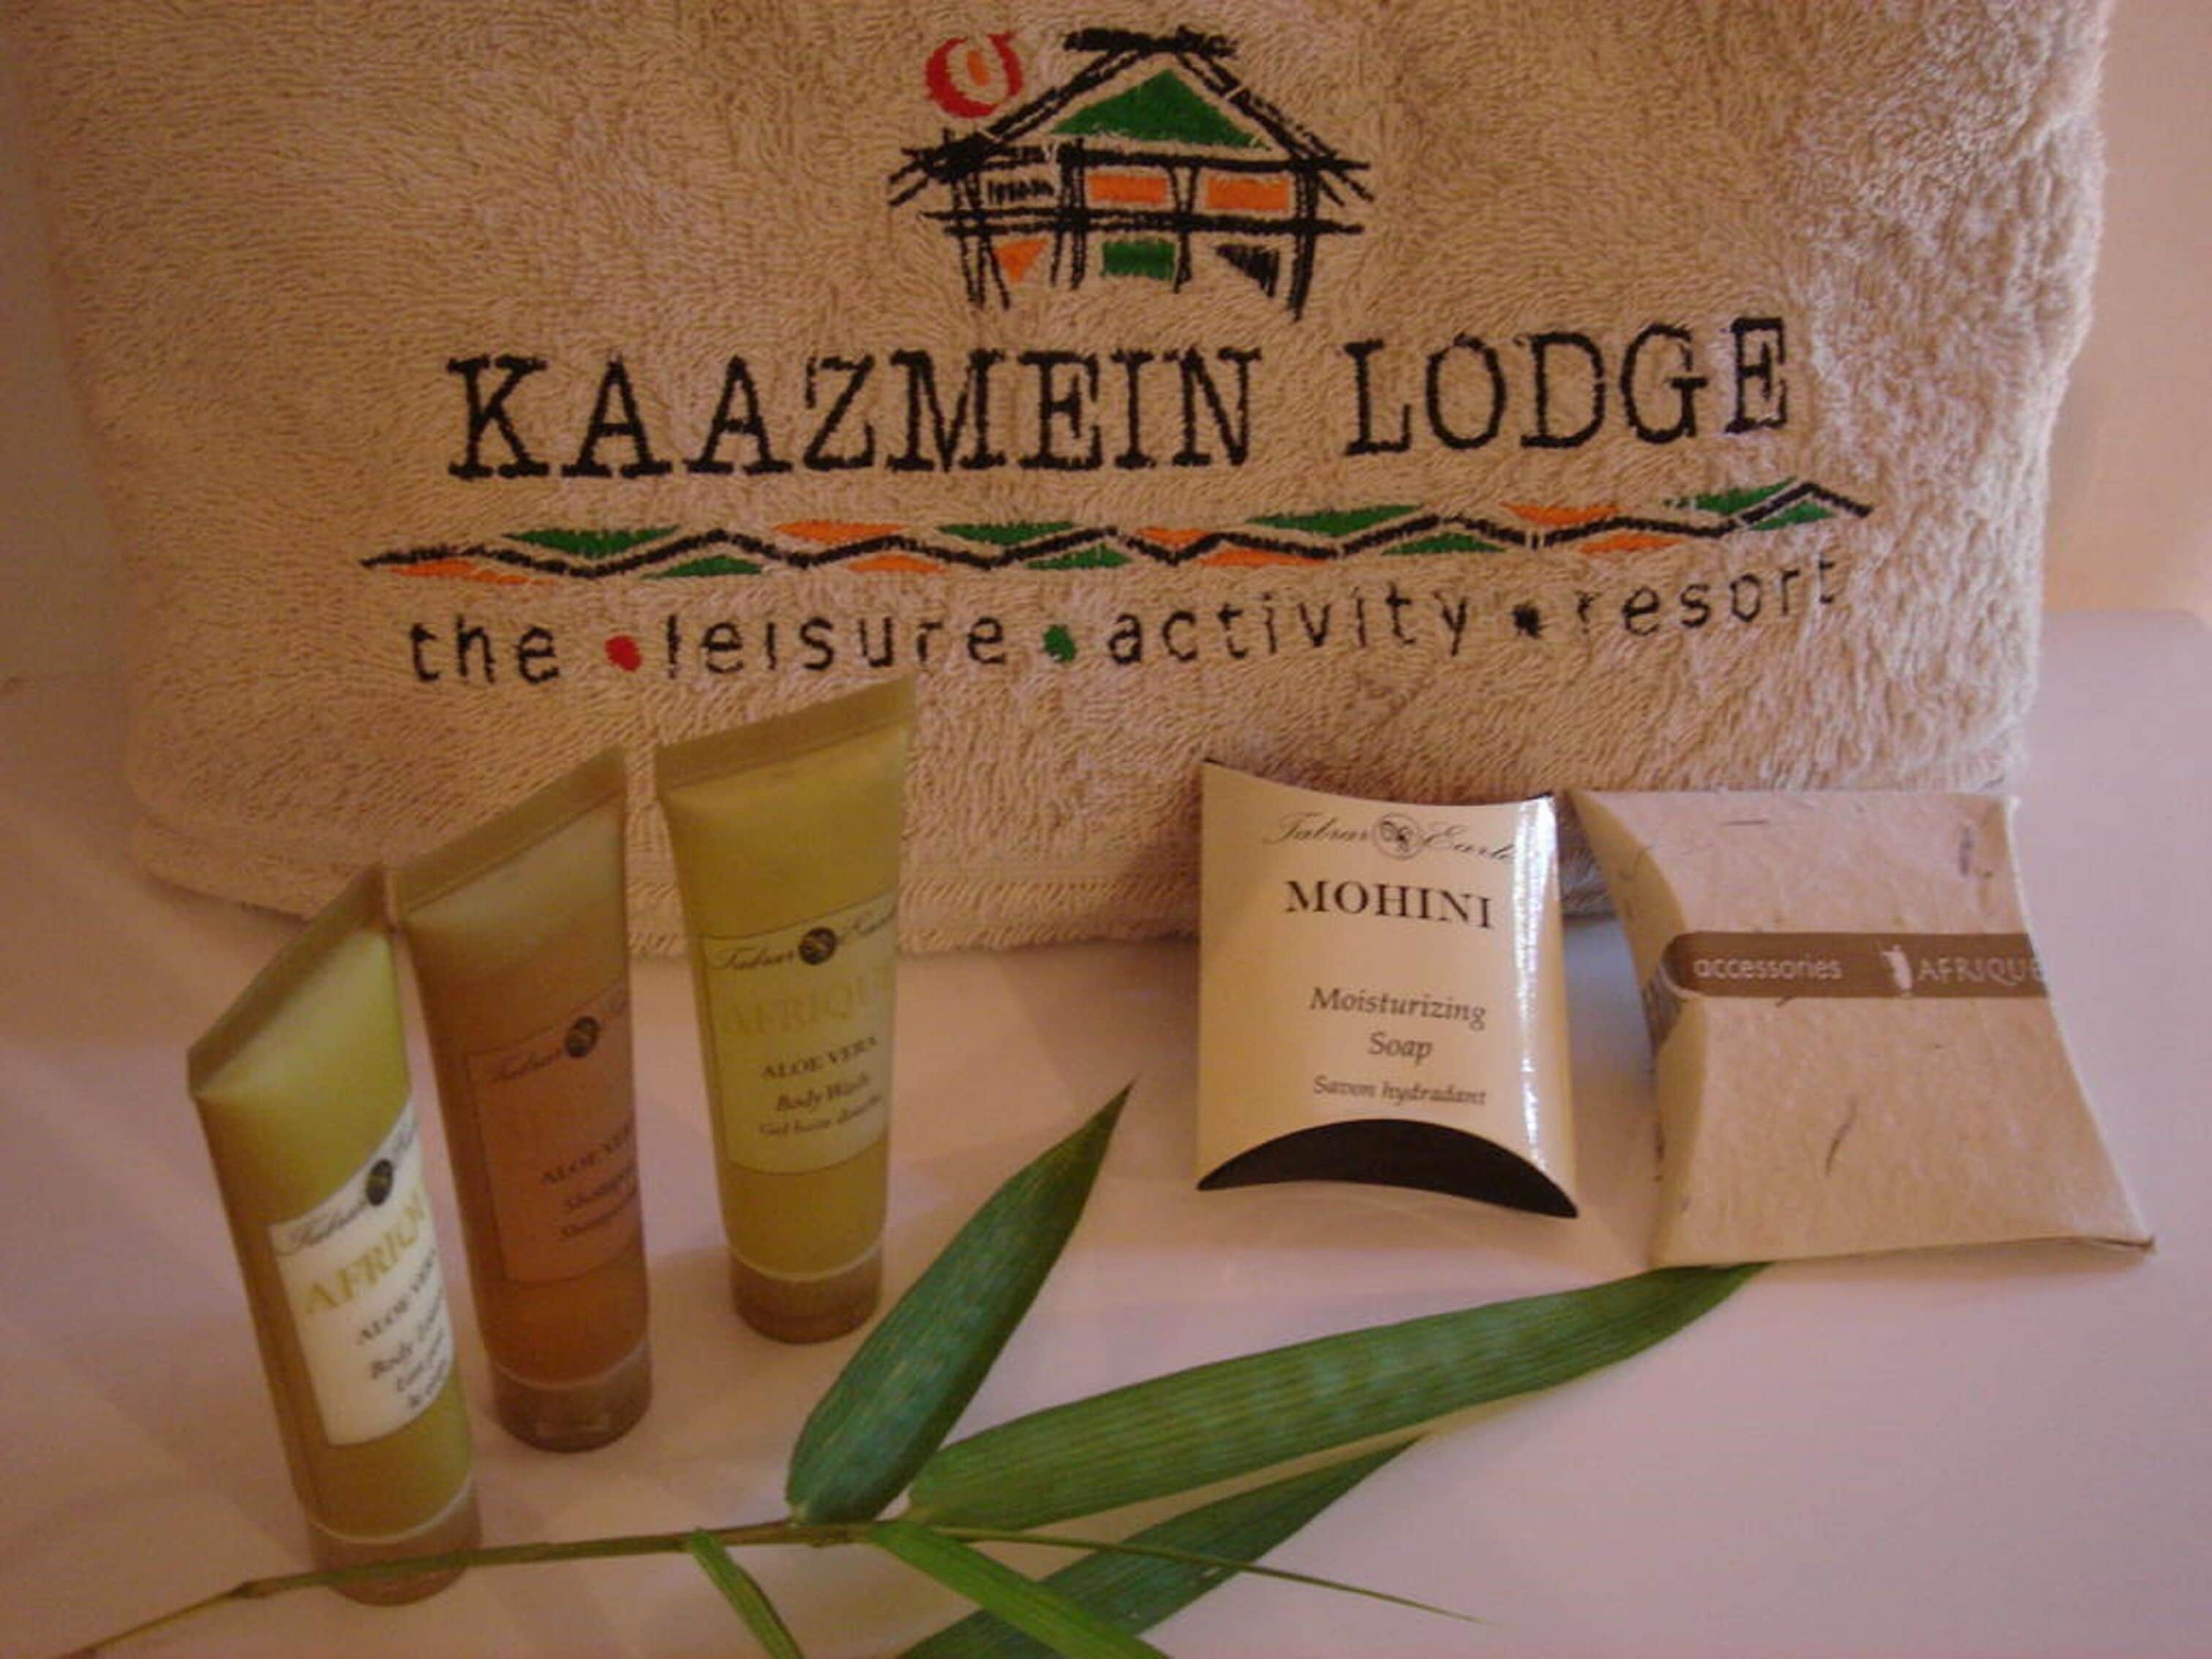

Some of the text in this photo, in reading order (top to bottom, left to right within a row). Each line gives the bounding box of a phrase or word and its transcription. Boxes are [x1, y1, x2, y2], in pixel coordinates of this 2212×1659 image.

[447, 317, 1787, 479] KAAZMEIN LODGE
[410, 549, 1835, 683] the leisure activity resort
[1285, 880, 1494, 929] MOHINI
[1694, 958, 1843, 980] accessories
[1309, 986, 1486, 1032] Moisturizing
[761, 1036, 878, 1080] ALOE VERA
[1368, 1031, 1433, 1066] Soap
[1313, 1074, 1377, 1097] Savon
